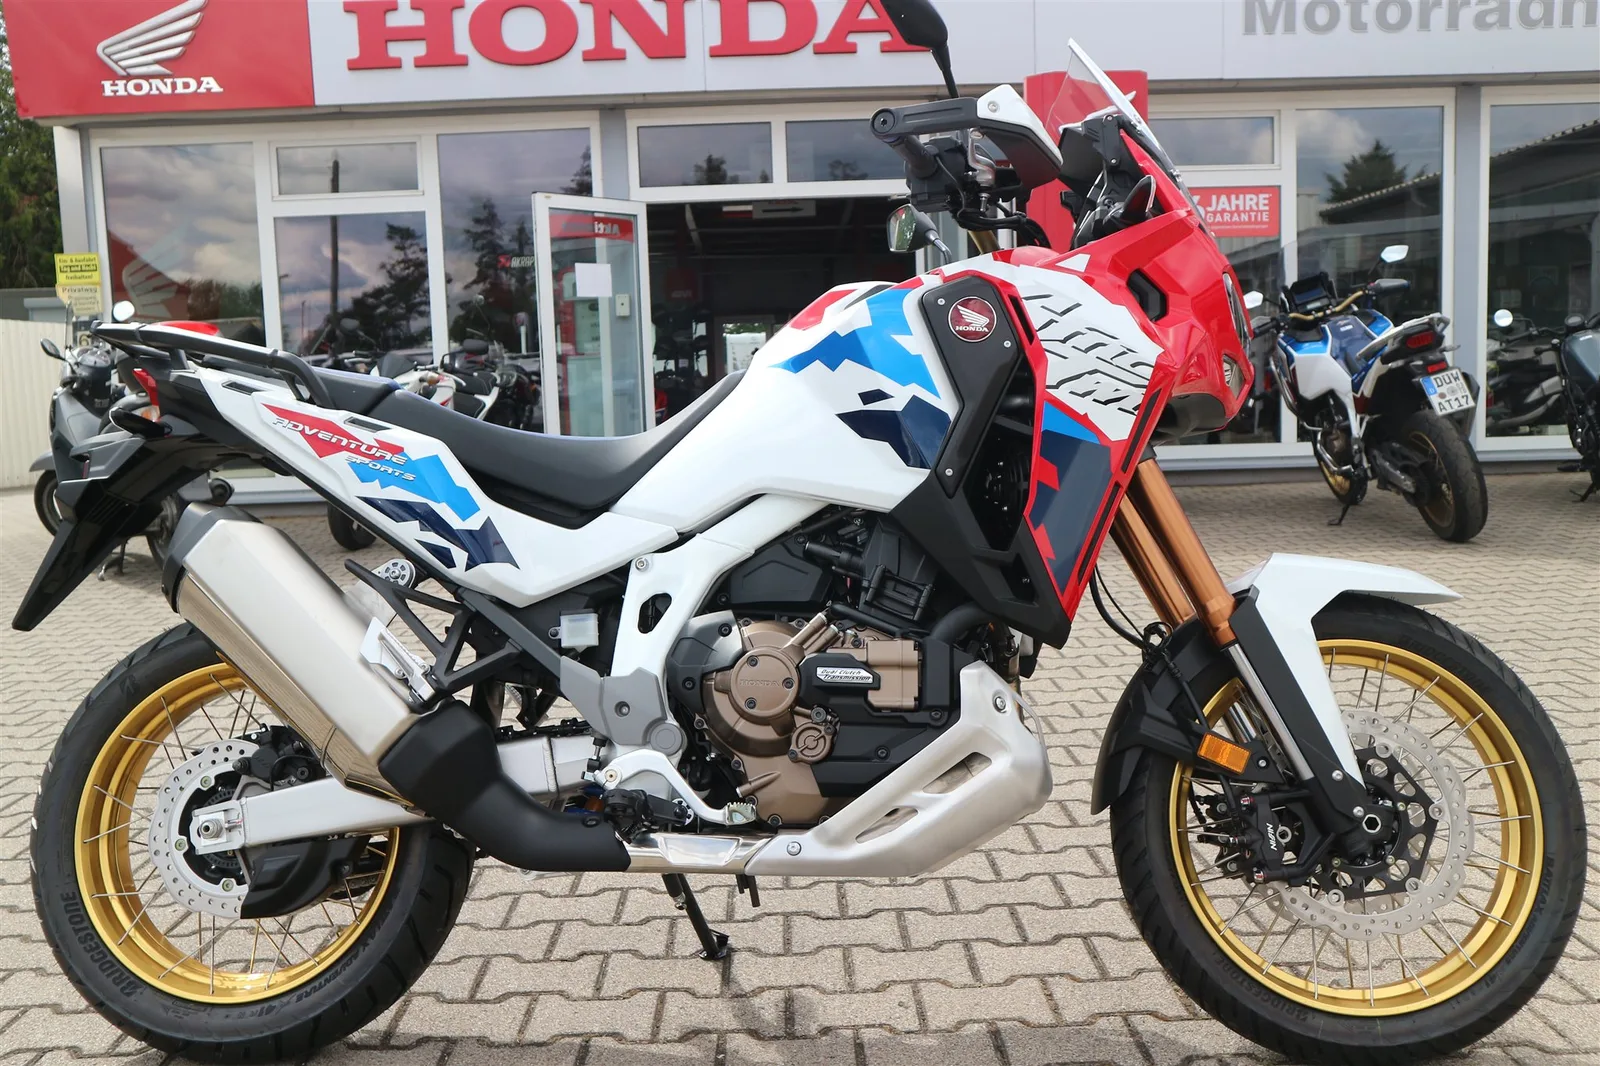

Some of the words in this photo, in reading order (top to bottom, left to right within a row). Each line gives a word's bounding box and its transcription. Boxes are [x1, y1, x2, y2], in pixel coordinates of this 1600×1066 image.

[343, 0, 931, 71] HONDA
[101, 77, 224, 96] HONDA
[1206, 193, 1270, 212] JAHRE
[1206, 211, 1270, 223] GARANTIE
[272, 417, 408, 465] ADVENTURE
[345, 455, 416, 481] SPORTS
[740, 679, 780, 687] HONDA
[60, 891, 139, 998] BRIDGESTONE
